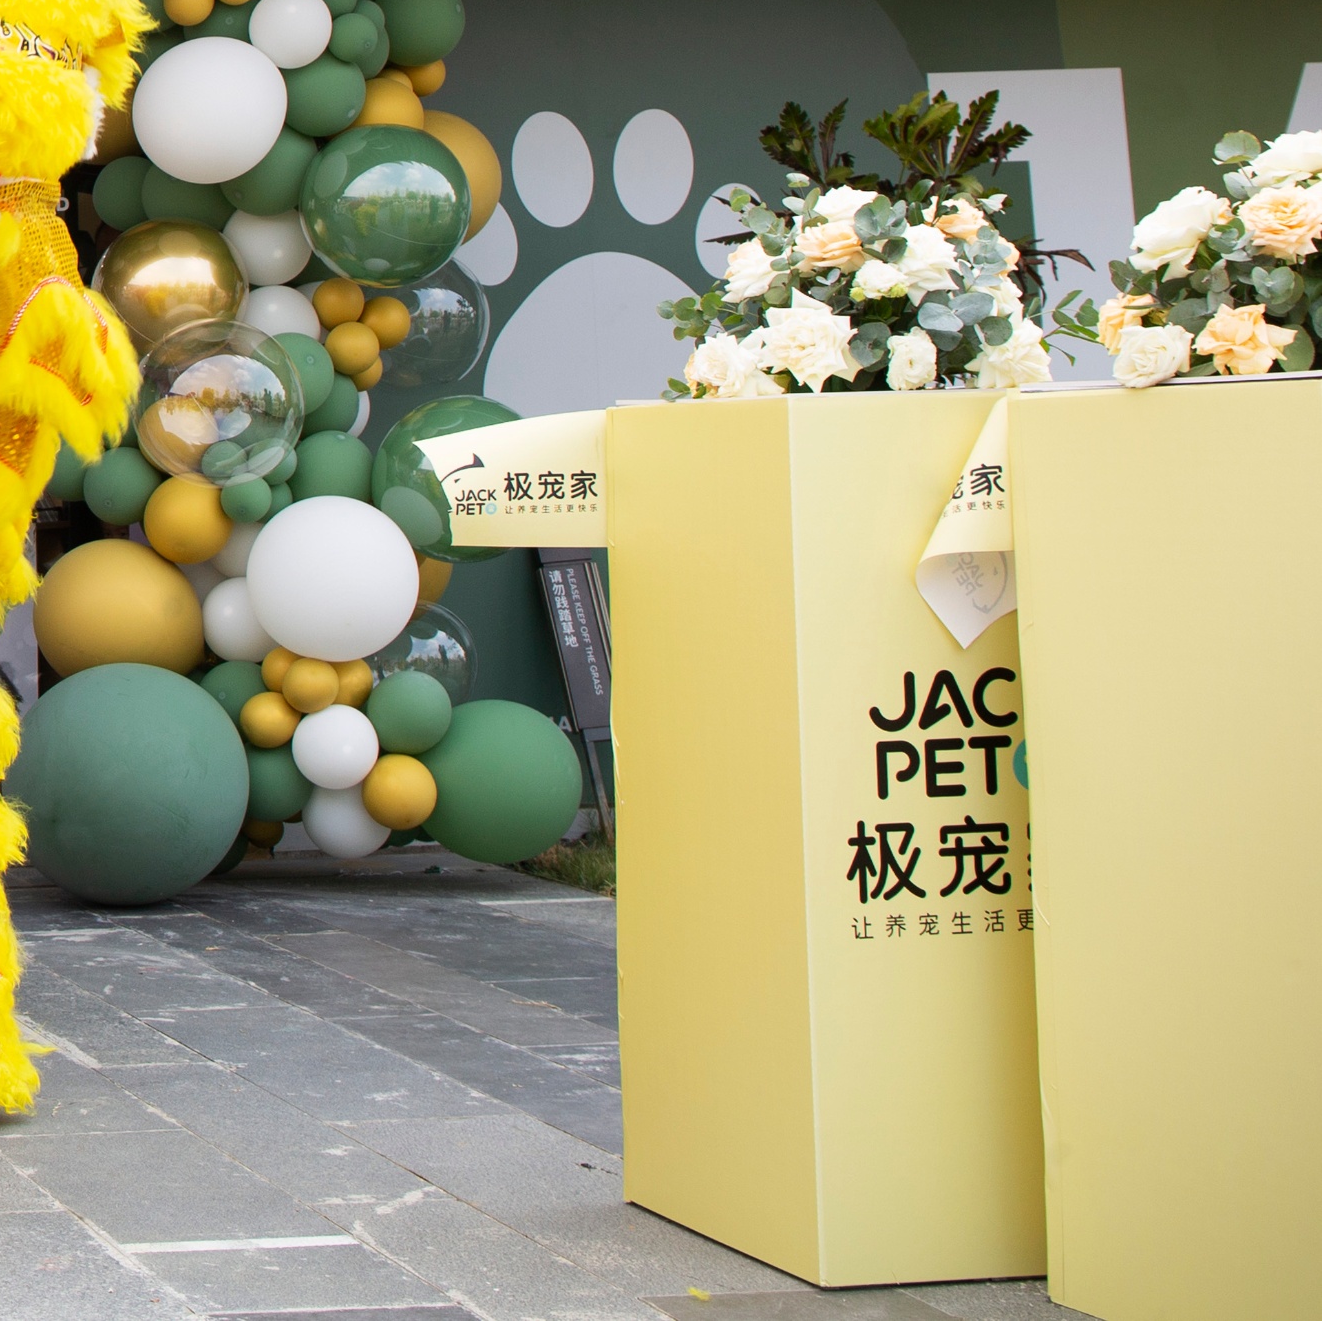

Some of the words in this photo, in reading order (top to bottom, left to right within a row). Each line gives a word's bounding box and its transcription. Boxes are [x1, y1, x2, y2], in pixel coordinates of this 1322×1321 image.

[454, 489, 497, 502] JACK
[503, 469, 599, 502] 极宠家
[504, 503, 598, 515] 让养宠生活更快乐
[566, 568, 581, 600] PLEASE
[548, 569, 579, 648] 请勿践踏草地
[574, 601, 586, 625] KEEP
[580, 625, 592, 644] OFF
[585, 645, 597, 664] THE
[589, 664, 604, 696] GRASS
[868, 666, 1018, 731] JAC
[875, 735, 1013, 800] PET
[846, 815, 1033, 904] 极宠
